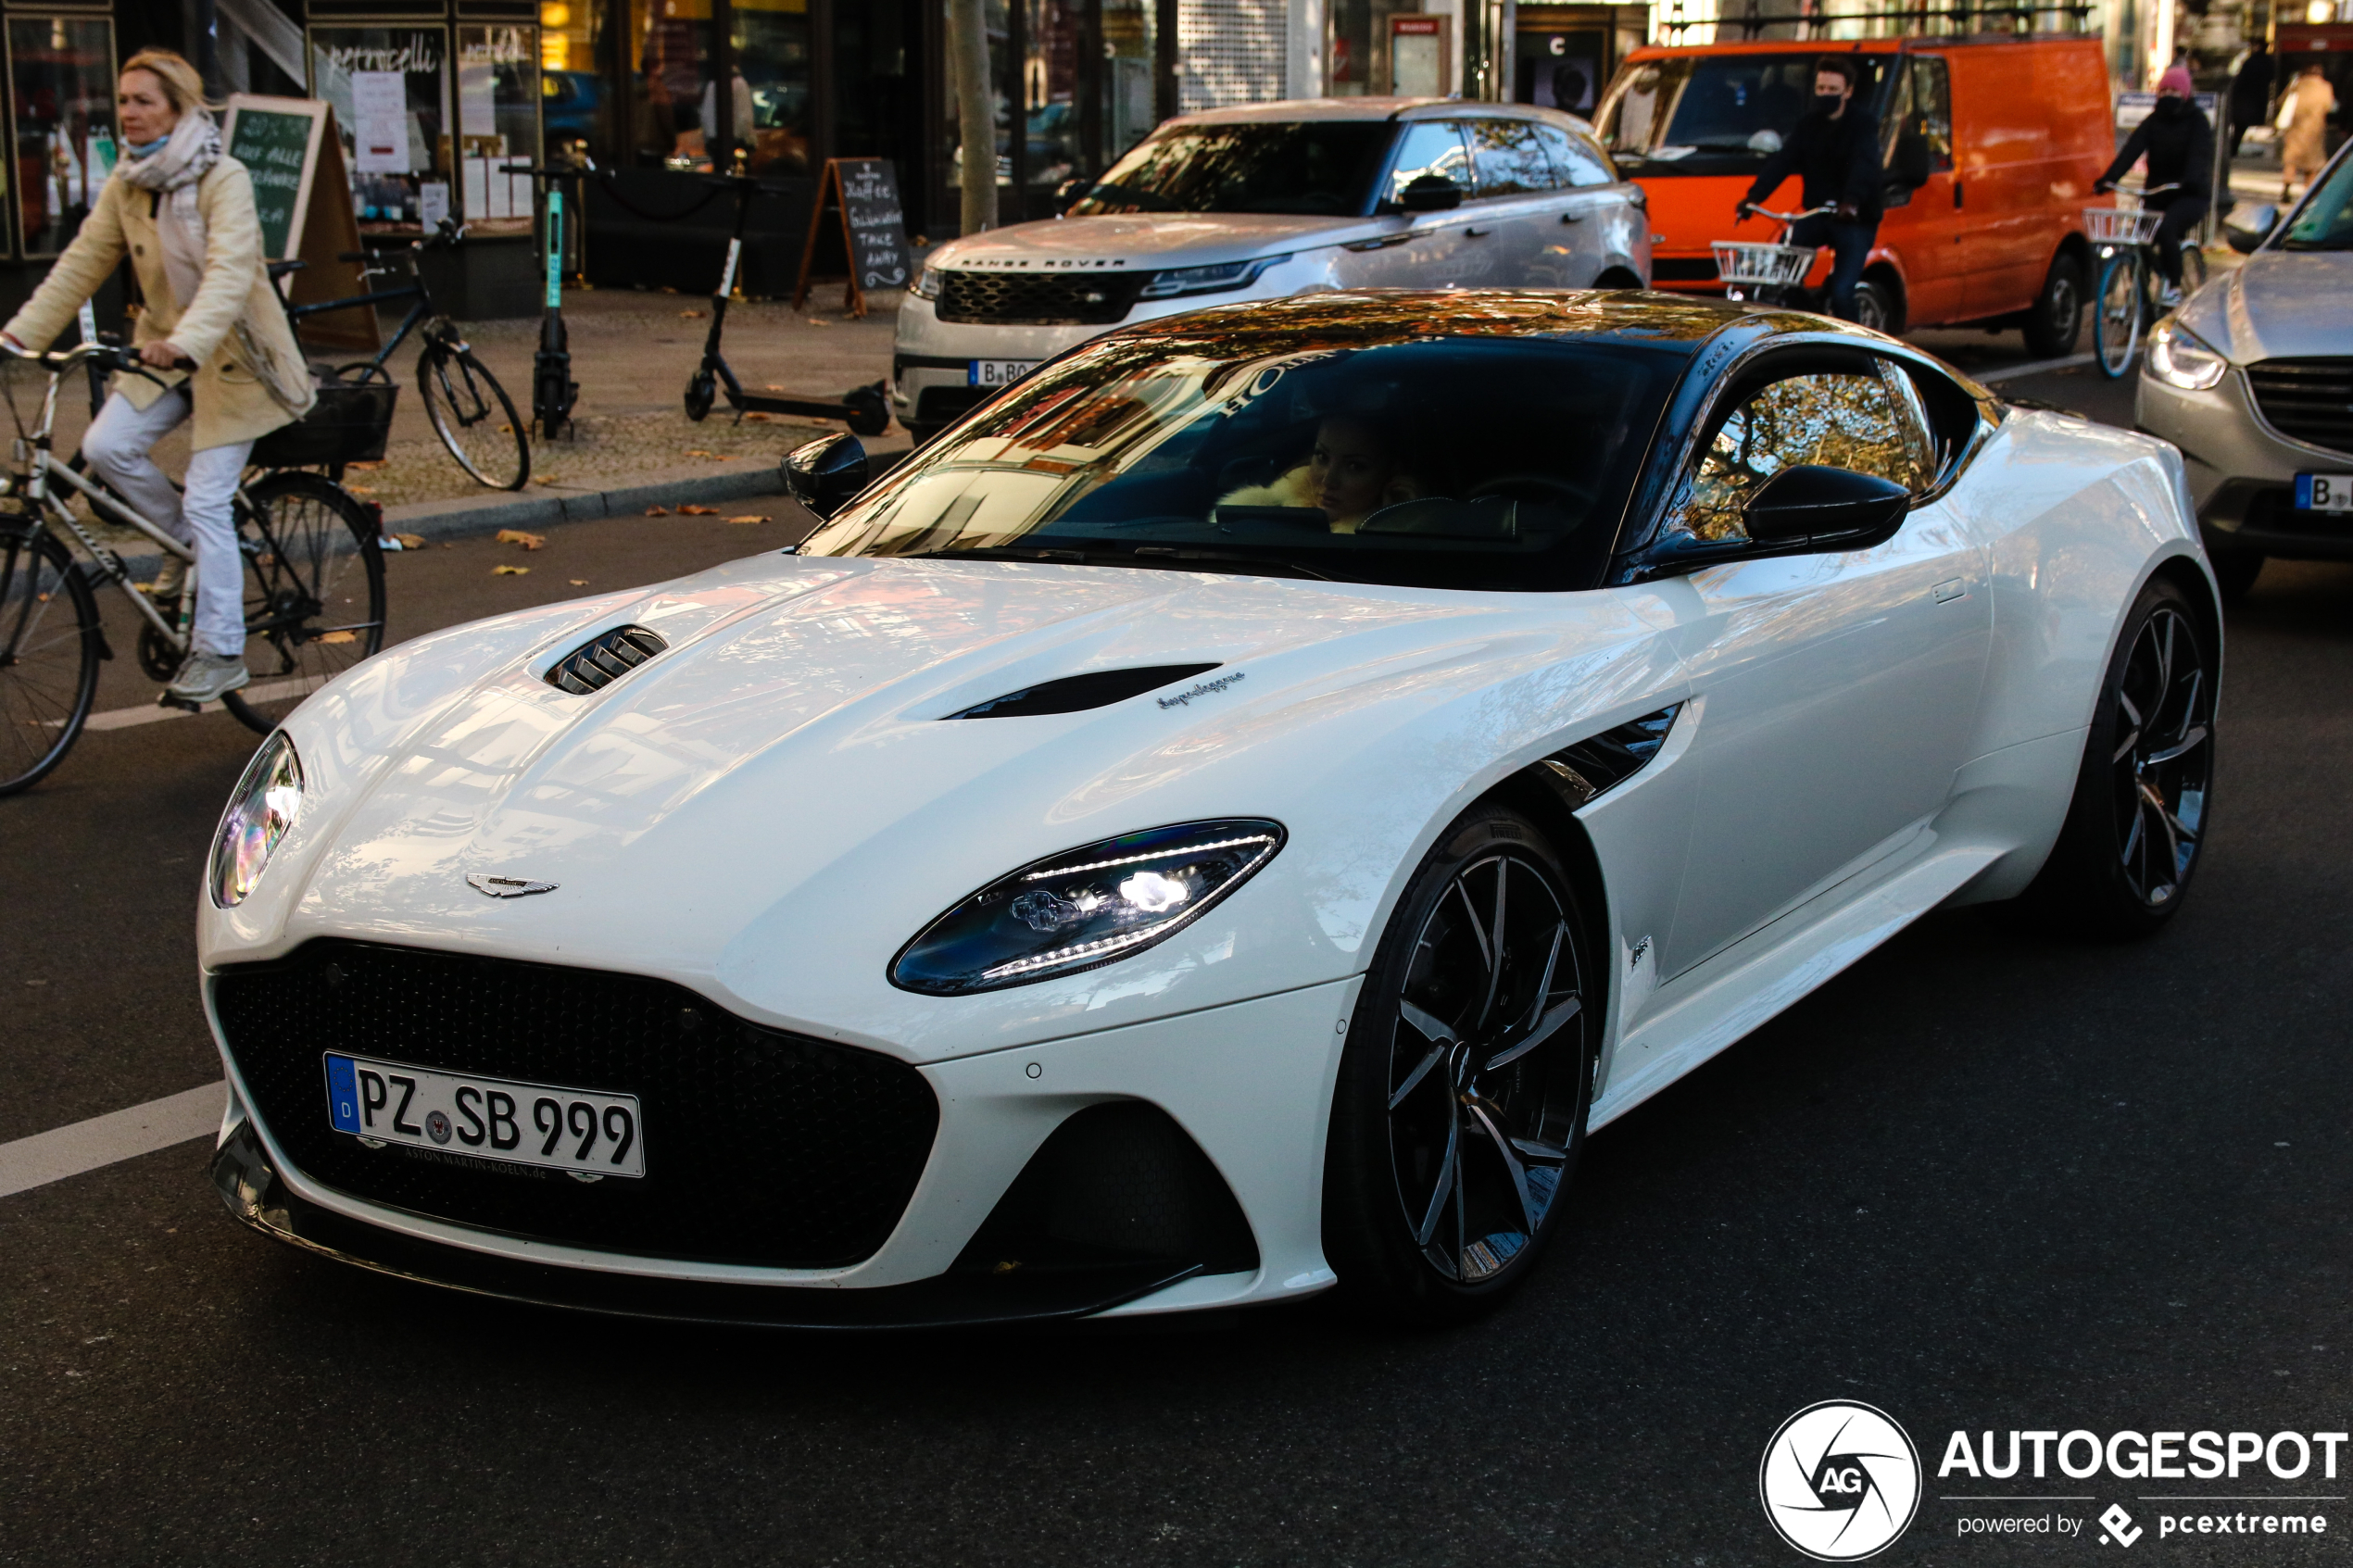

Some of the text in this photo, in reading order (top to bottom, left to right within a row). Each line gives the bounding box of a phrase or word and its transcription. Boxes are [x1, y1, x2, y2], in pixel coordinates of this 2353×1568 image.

[327, 31, 436, 83] petrocelli
[858, 232, 893, 246] TAKE
[866, 250, 899, 266] AWAY
[1044, 259, 1126, 268] ROVER
[985, 363, 995, 382] B
[2314, 479, 2330, 505] B
[1156, 671, 1246, 709] Superleggera
[1489, 823, 1522, 840] PIRELLI
[341, 1101, 351, 1118] D
[359, 1068, 635, 1164] PZ SB 999
[405, 1147, 441, 1162] ASTON
